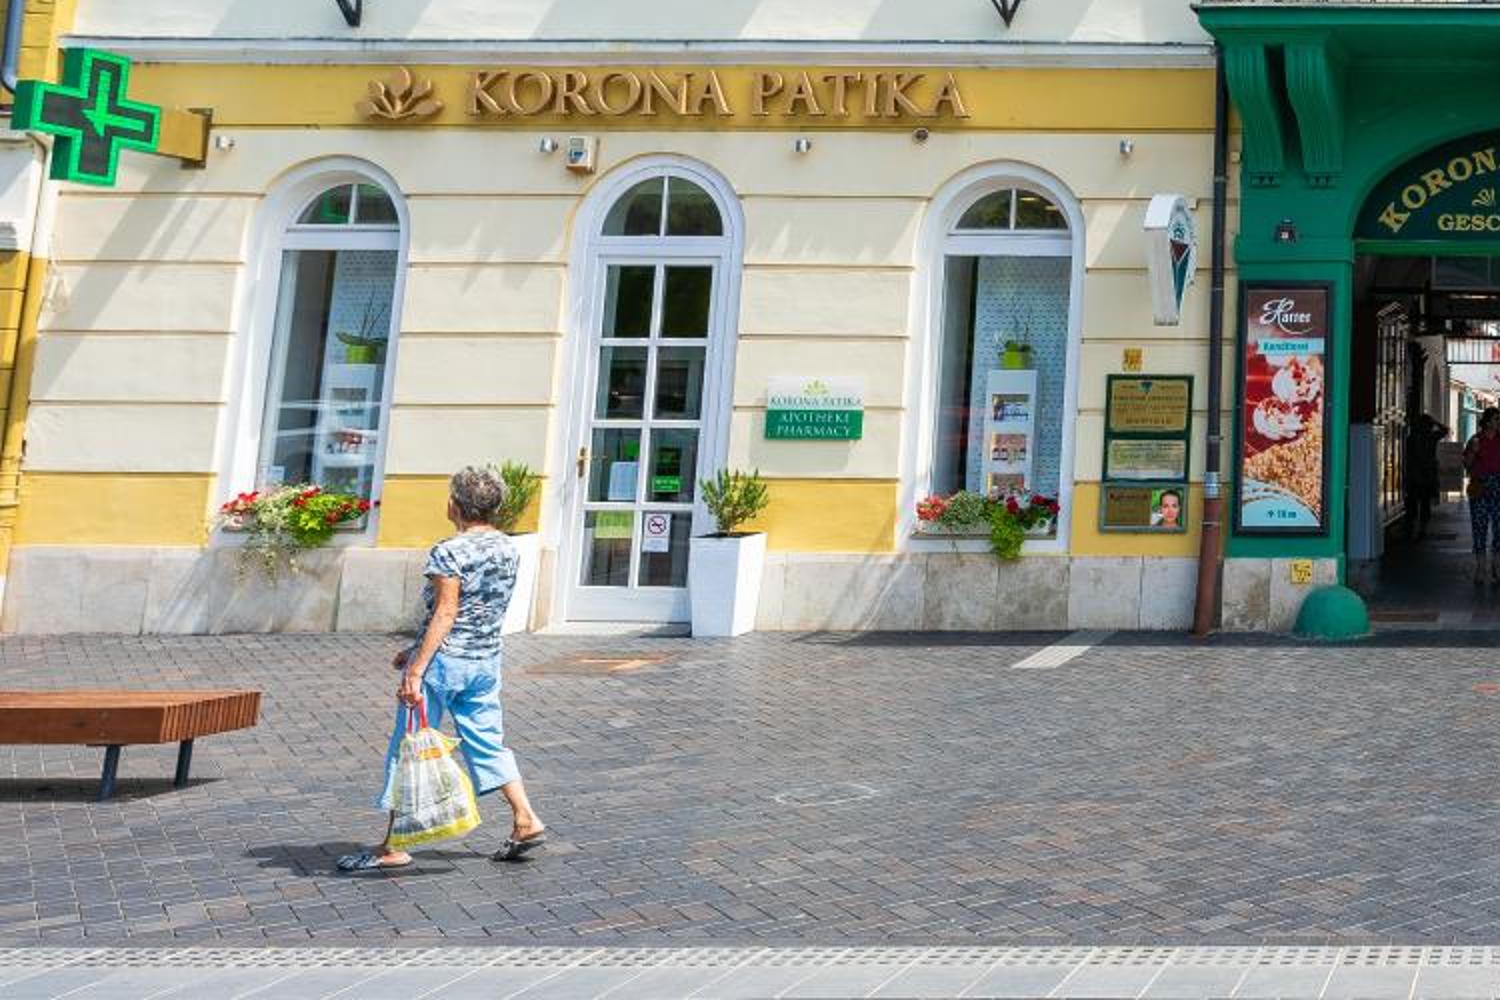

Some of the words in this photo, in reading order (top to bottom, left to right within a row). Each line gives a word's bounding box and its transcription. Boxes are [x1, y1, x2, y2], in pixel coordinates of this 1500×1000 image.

[468, 70, 735, 118] KORONA
[751, 70, 971, 119] PATIKA
[770, 396, 817, 406] KORONA
[777, 425, 851, 437] PHARMACY
